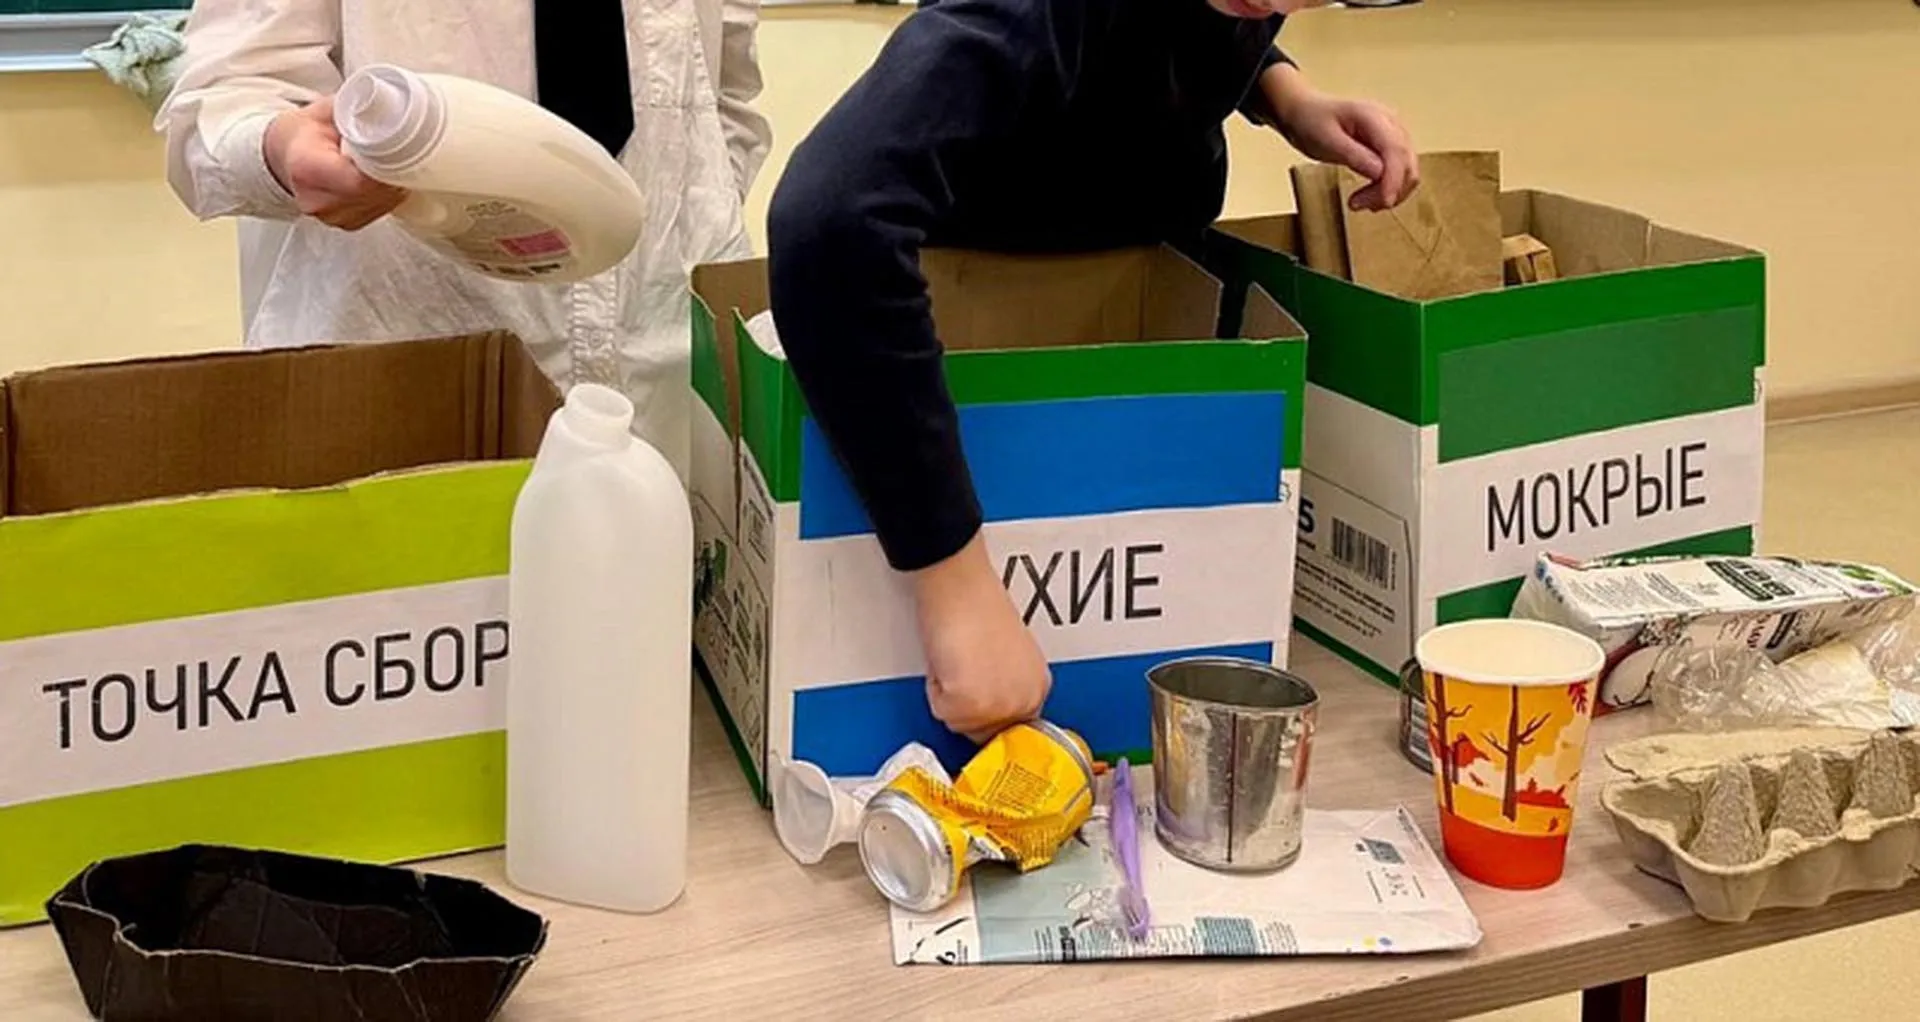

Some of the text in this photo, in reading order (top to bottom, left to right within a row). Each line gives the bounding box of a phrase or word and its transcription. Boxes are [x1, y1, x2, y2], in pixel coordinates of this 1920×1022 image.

[1487, 442, 1707, 552] МОКРЫЕ
[42, 620, 510, 749] ТОЧКА СБОР
